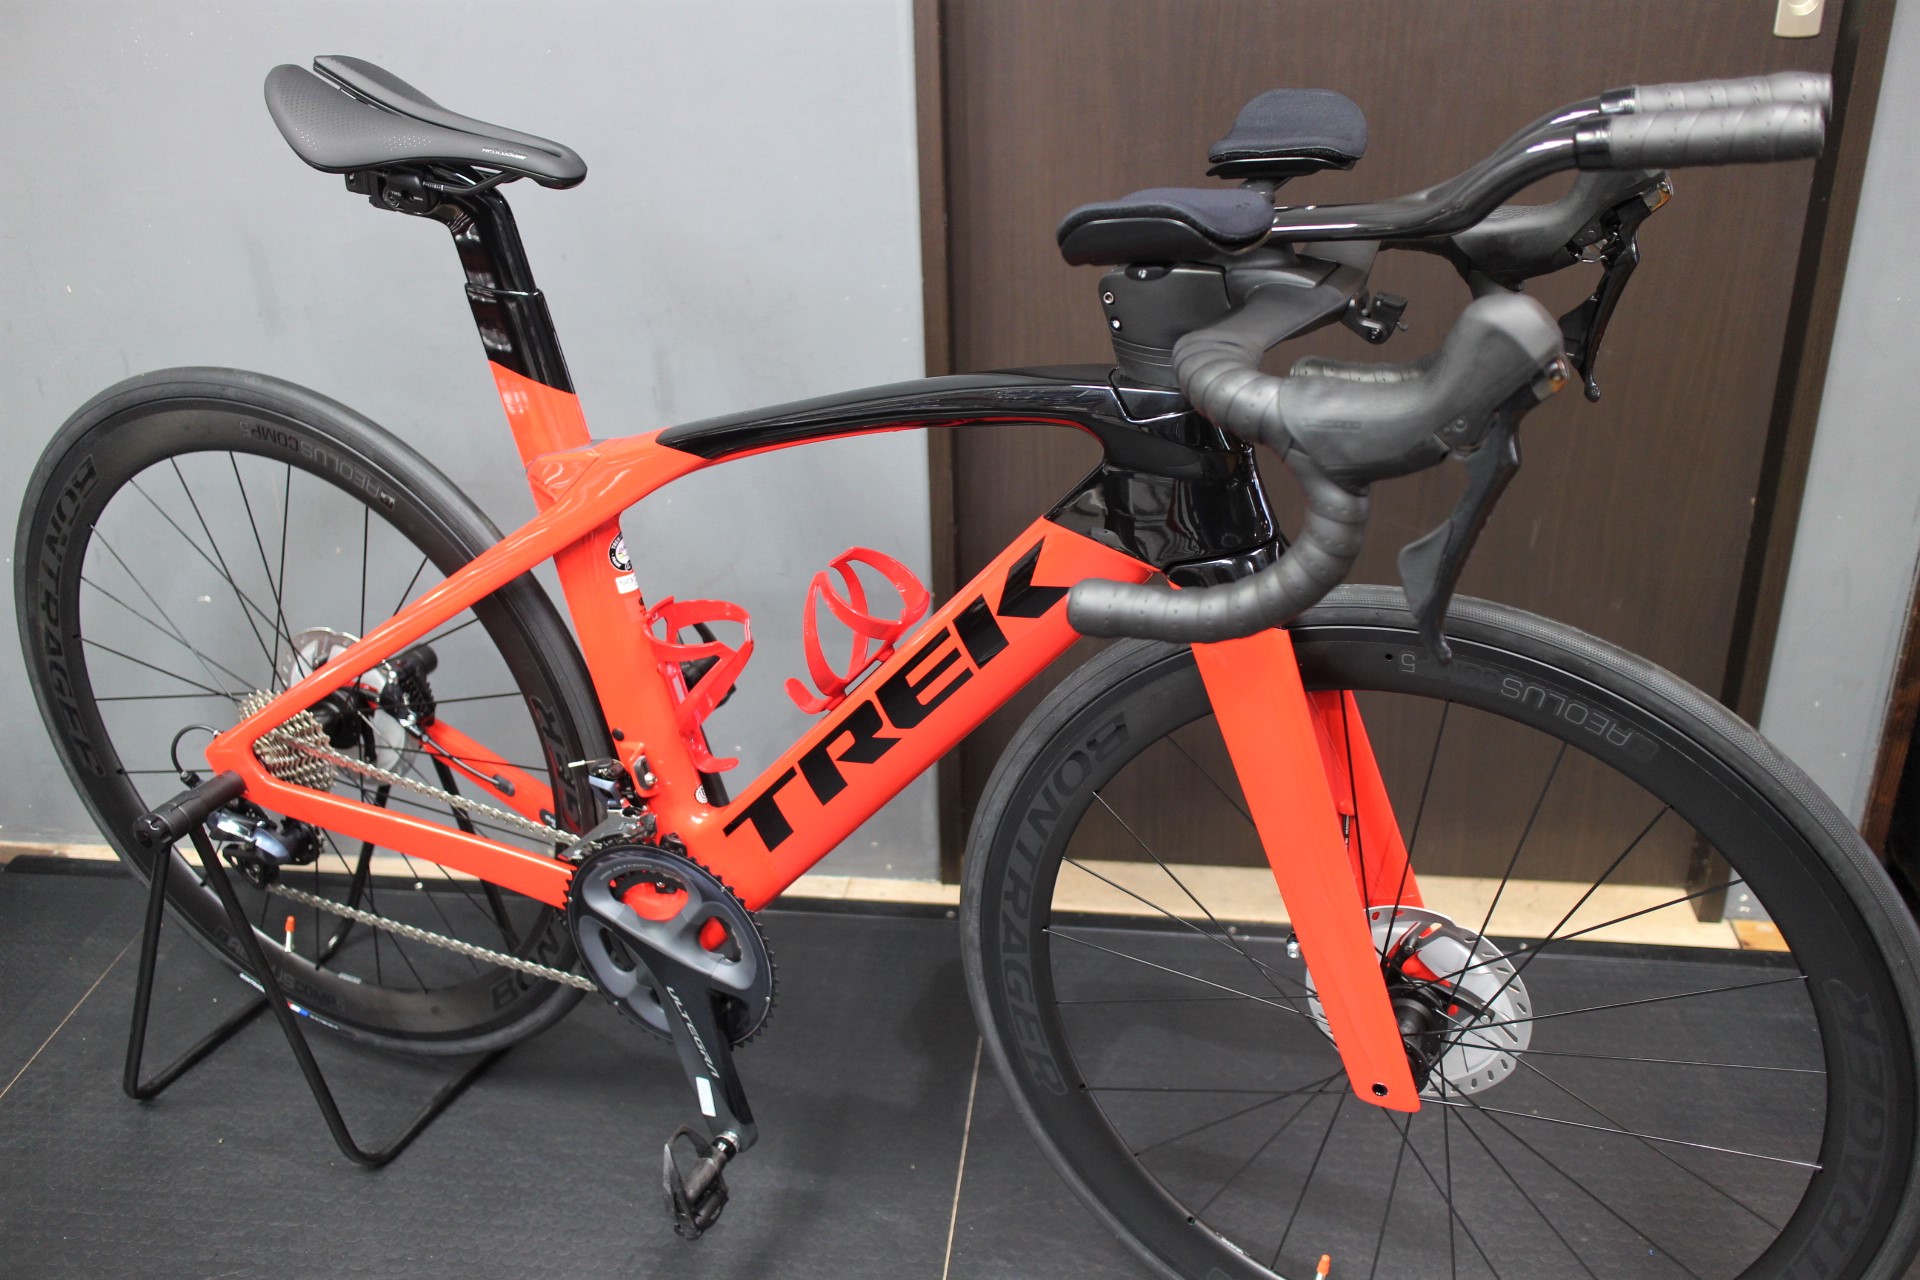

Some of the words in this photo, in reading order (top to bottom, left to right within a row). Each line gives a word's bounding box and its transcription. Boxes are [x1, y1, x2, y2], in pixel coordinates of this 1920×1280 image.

[722, 535, 1074, 853] TREK
[1500, 674, 1634, 746] AEOLUS
[1001, 710, 1132, 1096] BONTRAGER
[666, 986, 720, 1078] ULTEGRA
